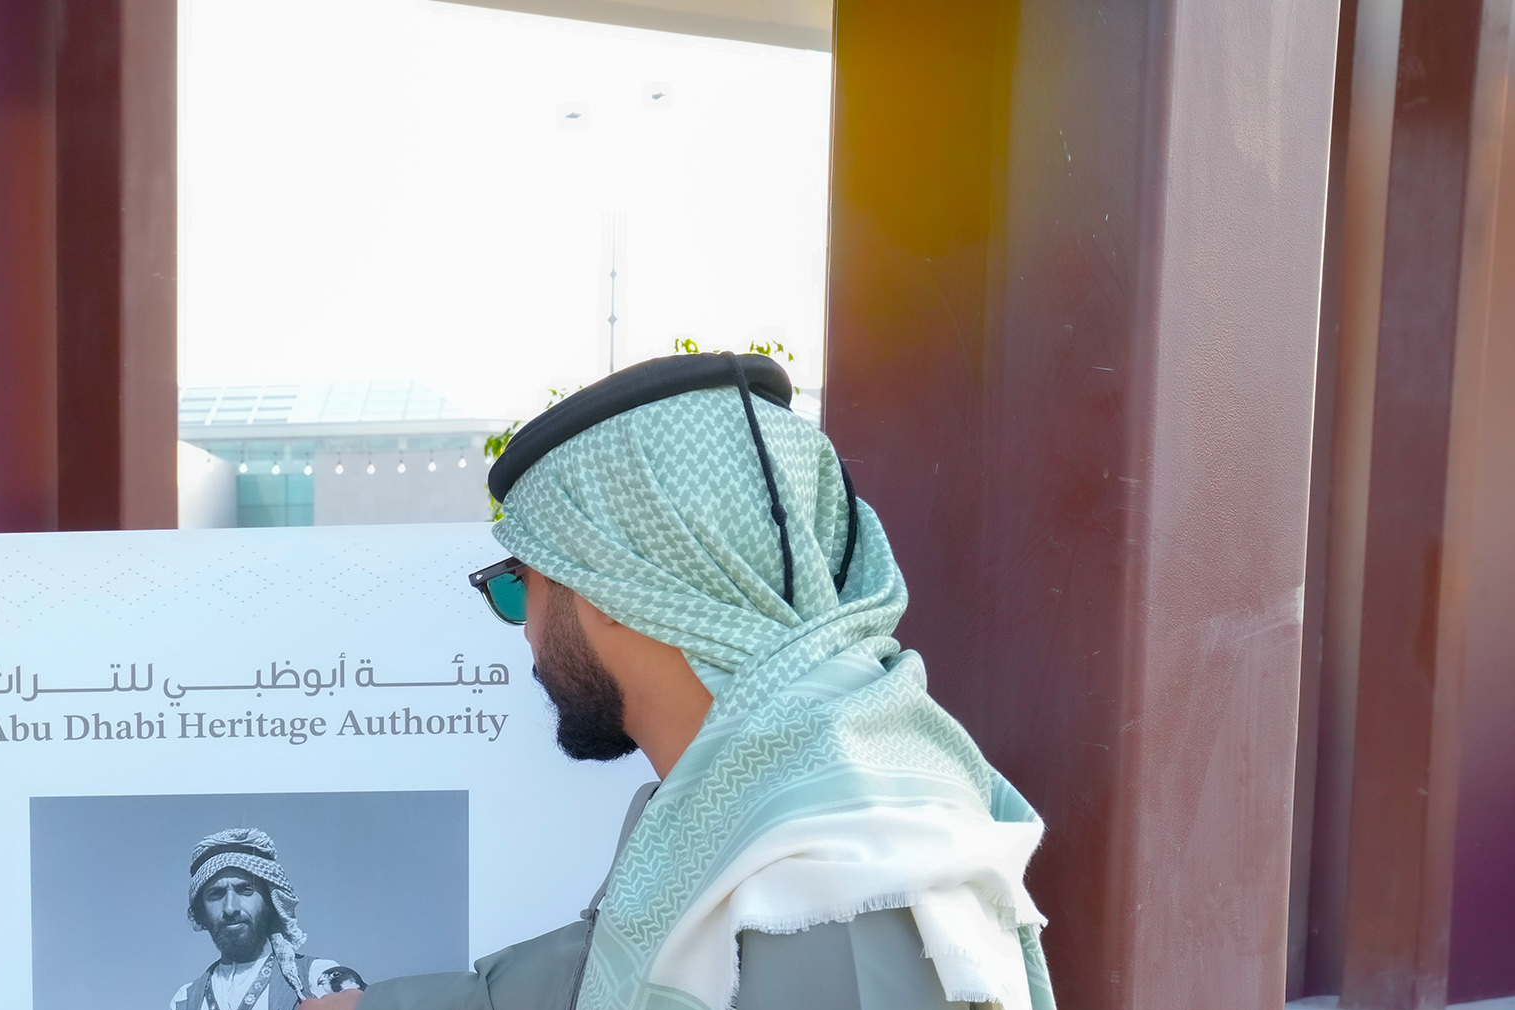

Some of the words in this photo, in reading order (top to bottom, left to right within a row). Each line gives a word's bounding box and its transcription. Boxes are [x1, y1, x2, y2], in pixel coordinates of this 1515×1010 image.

[63, 712, 167, 742] Dhabi
[177, 710, 327, 746] Heritage
[336, 706, 509, 743] Authority
